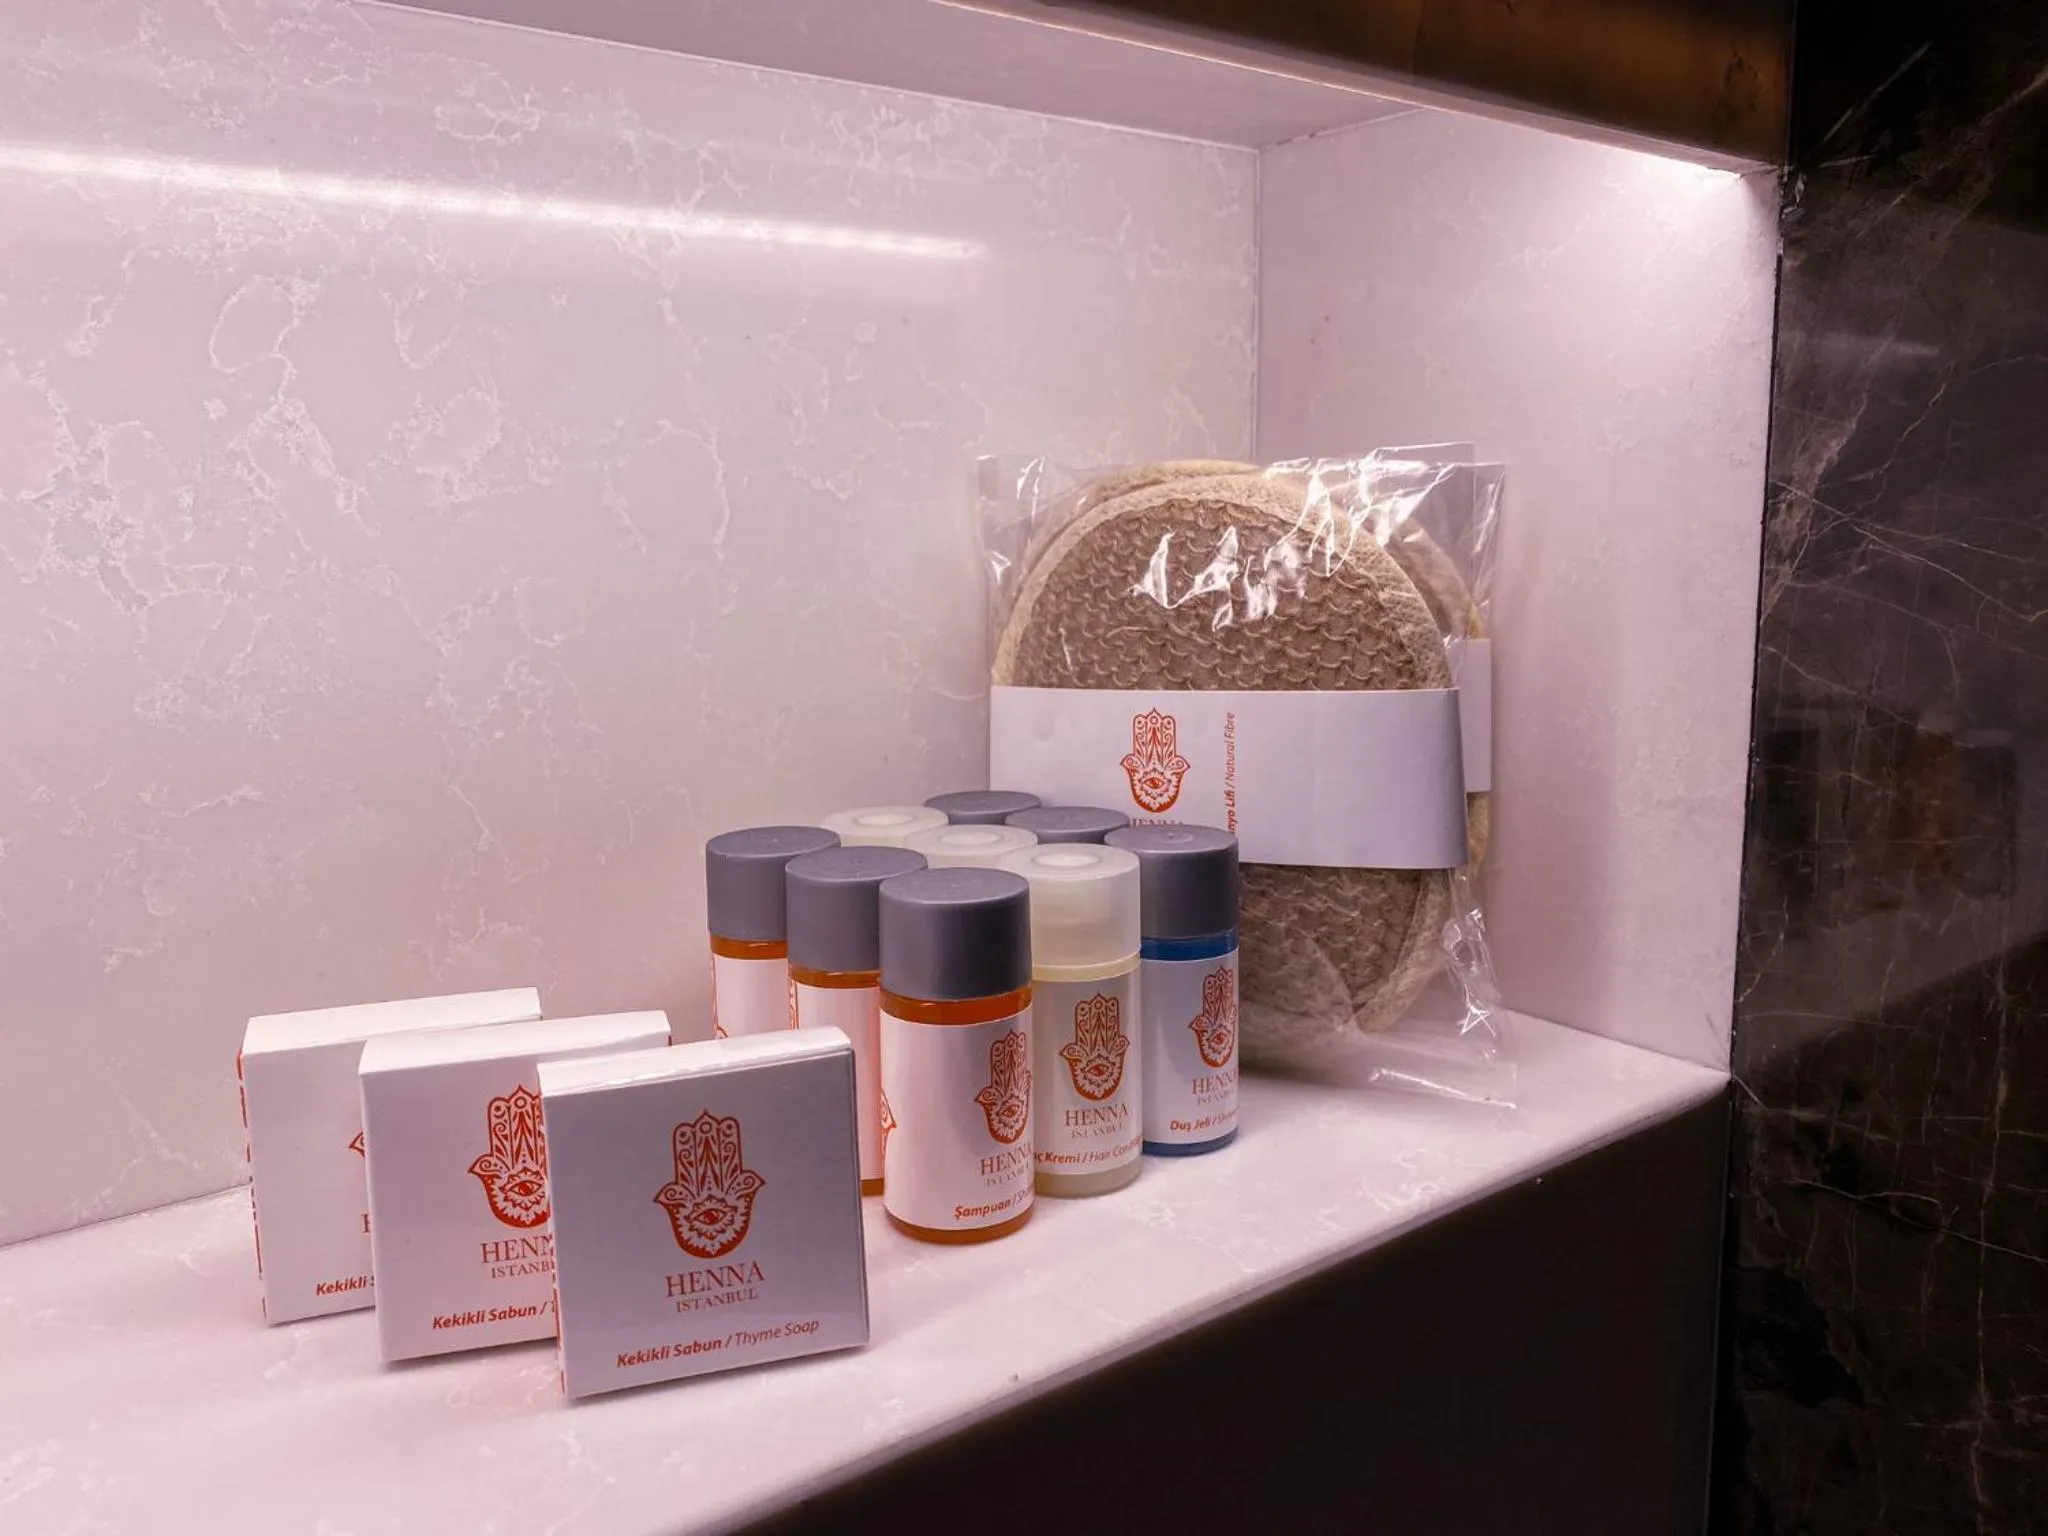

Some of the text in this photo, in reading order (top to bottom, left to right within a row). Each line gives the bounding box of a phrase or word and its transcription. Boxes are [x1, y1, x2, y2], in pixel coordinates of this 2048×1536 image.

[1224, 712, 1236, 739] Fibre
[1224, 740, 1236, 781] Natural
[1227, 810, 1239, 834] nyo
[1064, 1103, 1128, 1127] HENNA
[1170, 1119, 1191, 1132] Duş
[1044, 1150, 1081, 1164] Kremi
[1089, 1148, 1112, 1162] Hair
[954, 1199, 1011, 1220] Şampuan
[480, 1233, 553, 1264] HENN
[491, 1259, 551, 1279] ISTANB
[664, 1259, 766, 1298] HENNA
[315, 1275, 367, 1296] Kekikli
[675, 1287, 760, 1314] ISTANBUL
[432, 1309, 486, 1330] Kekikli
[487, 1305, 537, 1322] Sabun
[615, 1345, 671, 1368] Kekikli
[672, 1338, 723, 1358] Sabun
[734, 1326, 782, 1346] Thyme
[784, 1319, 820, 1336] Soap
